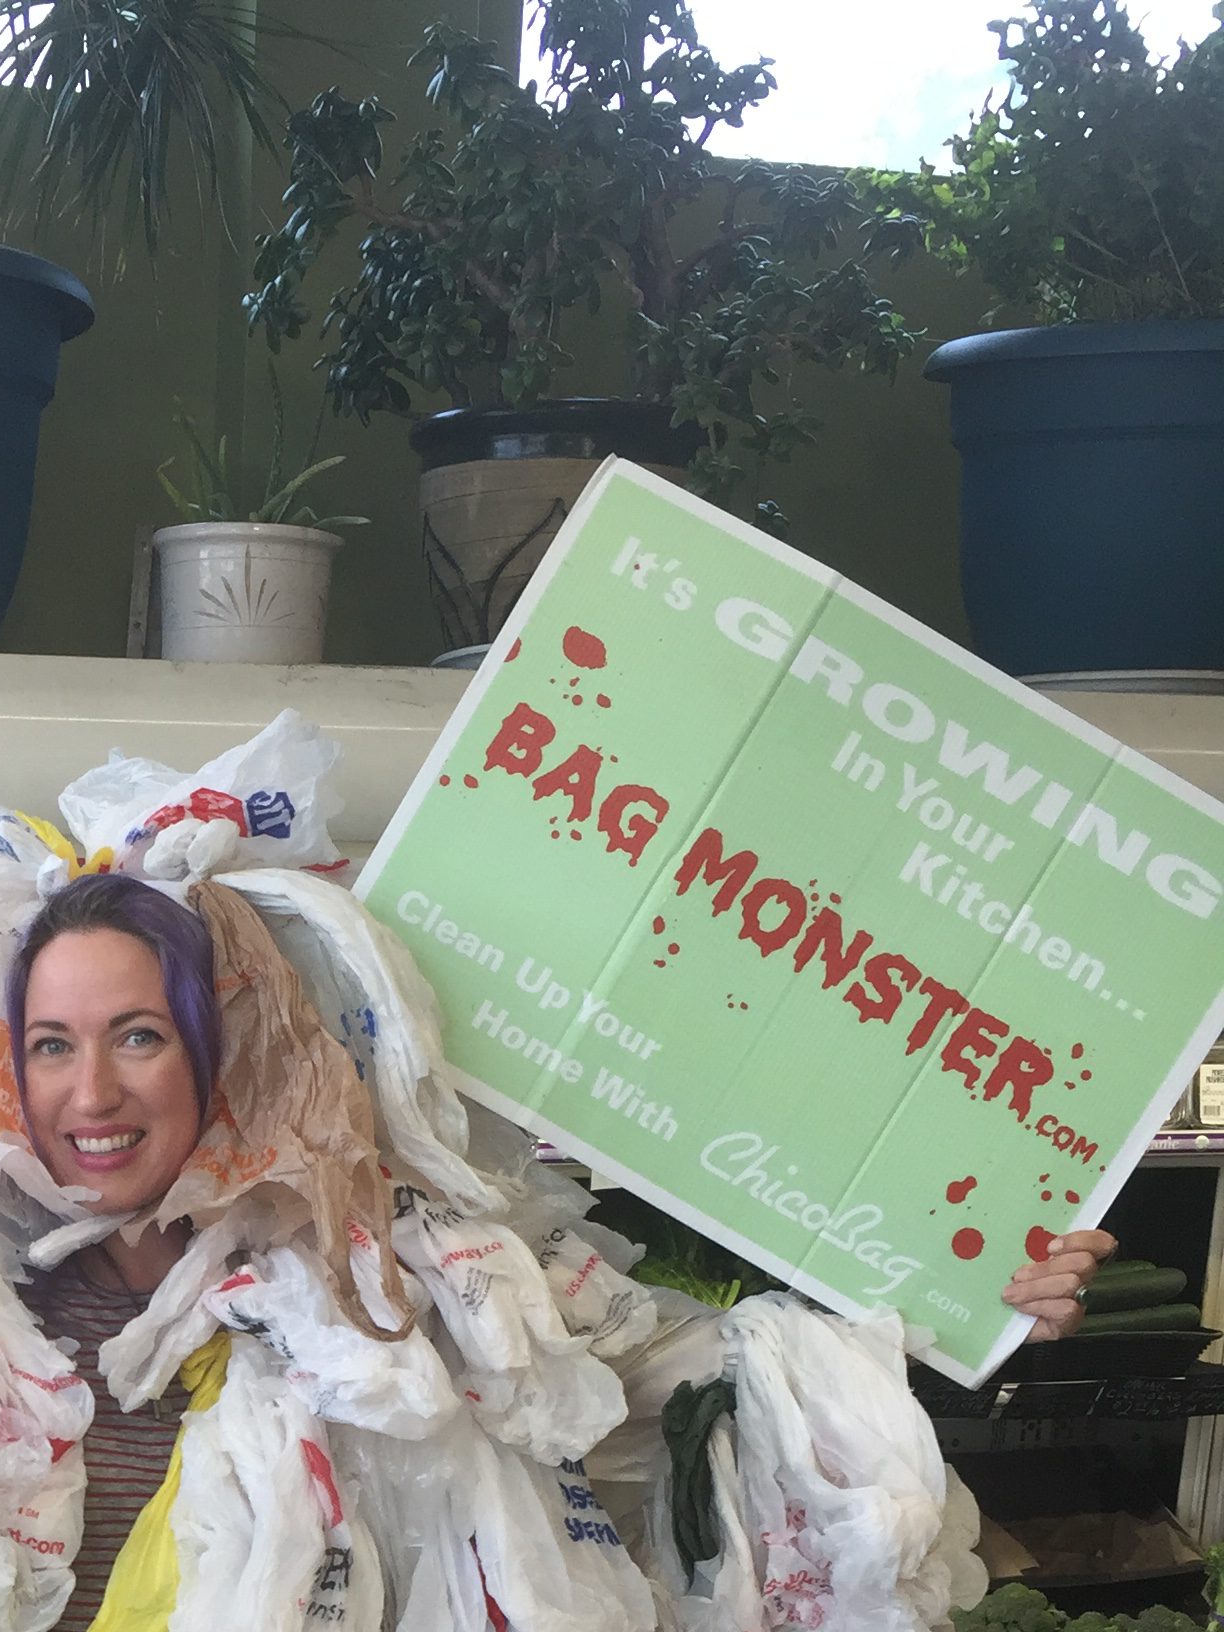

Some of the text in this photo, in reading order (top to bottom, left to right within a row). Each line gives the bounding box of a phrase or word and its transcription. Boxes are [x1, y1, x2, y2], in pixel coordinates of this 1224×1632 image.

[484, 702, 670, 866] BAG
[610, 537, 1223, 919] It's GROWING
[831, 730, 1015, 863] In Your
[397, 890, 662, 1061] Clean Up Your
[898, 841, 1147, 1022] Kitchen...
[471, 999, 678, 1142] Home With
[699, 1131, 926, 1295] ChicoBag
